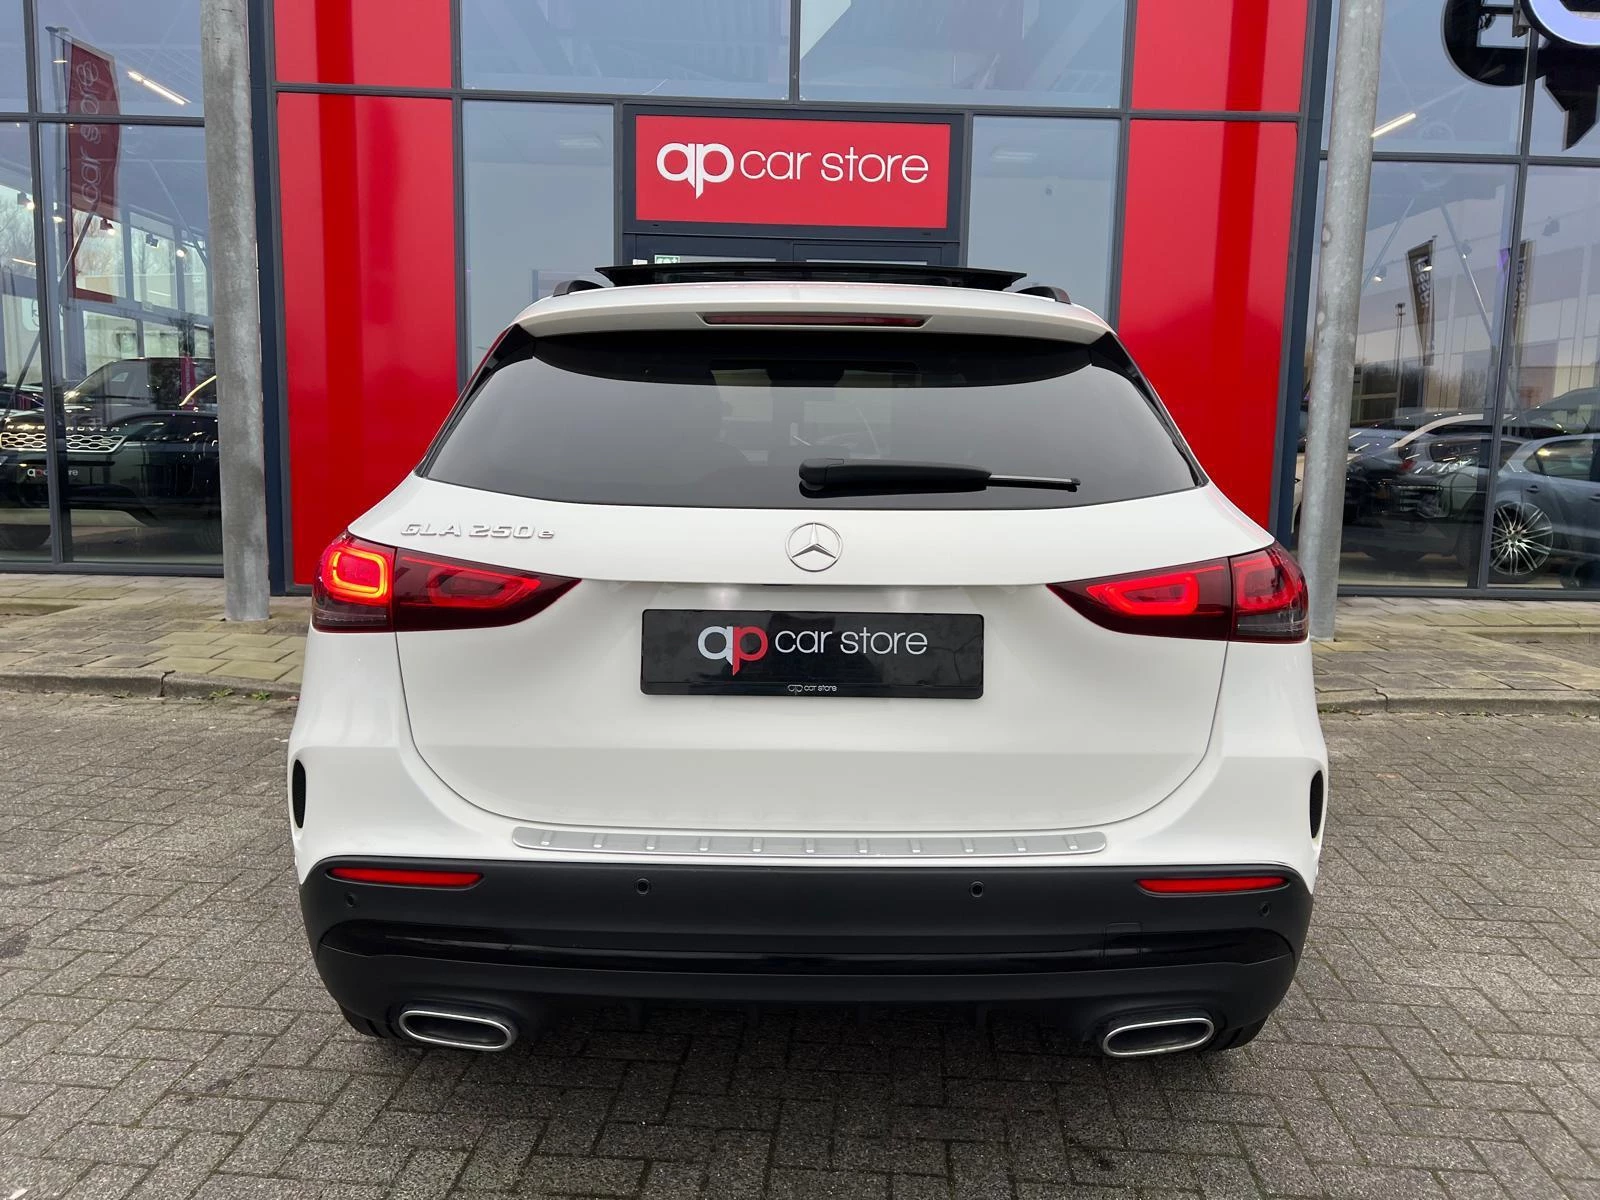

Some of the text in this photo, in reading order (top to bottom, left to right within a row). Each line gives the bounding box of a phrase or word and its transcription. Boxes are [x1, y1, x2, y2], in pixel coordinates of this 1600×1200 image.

[76, 61, 101, 144] sore
[656, 142, 929, 199] ap car store
[401, 521, 461, 537] GLA
[697, 625, 928, 676] ap car store
